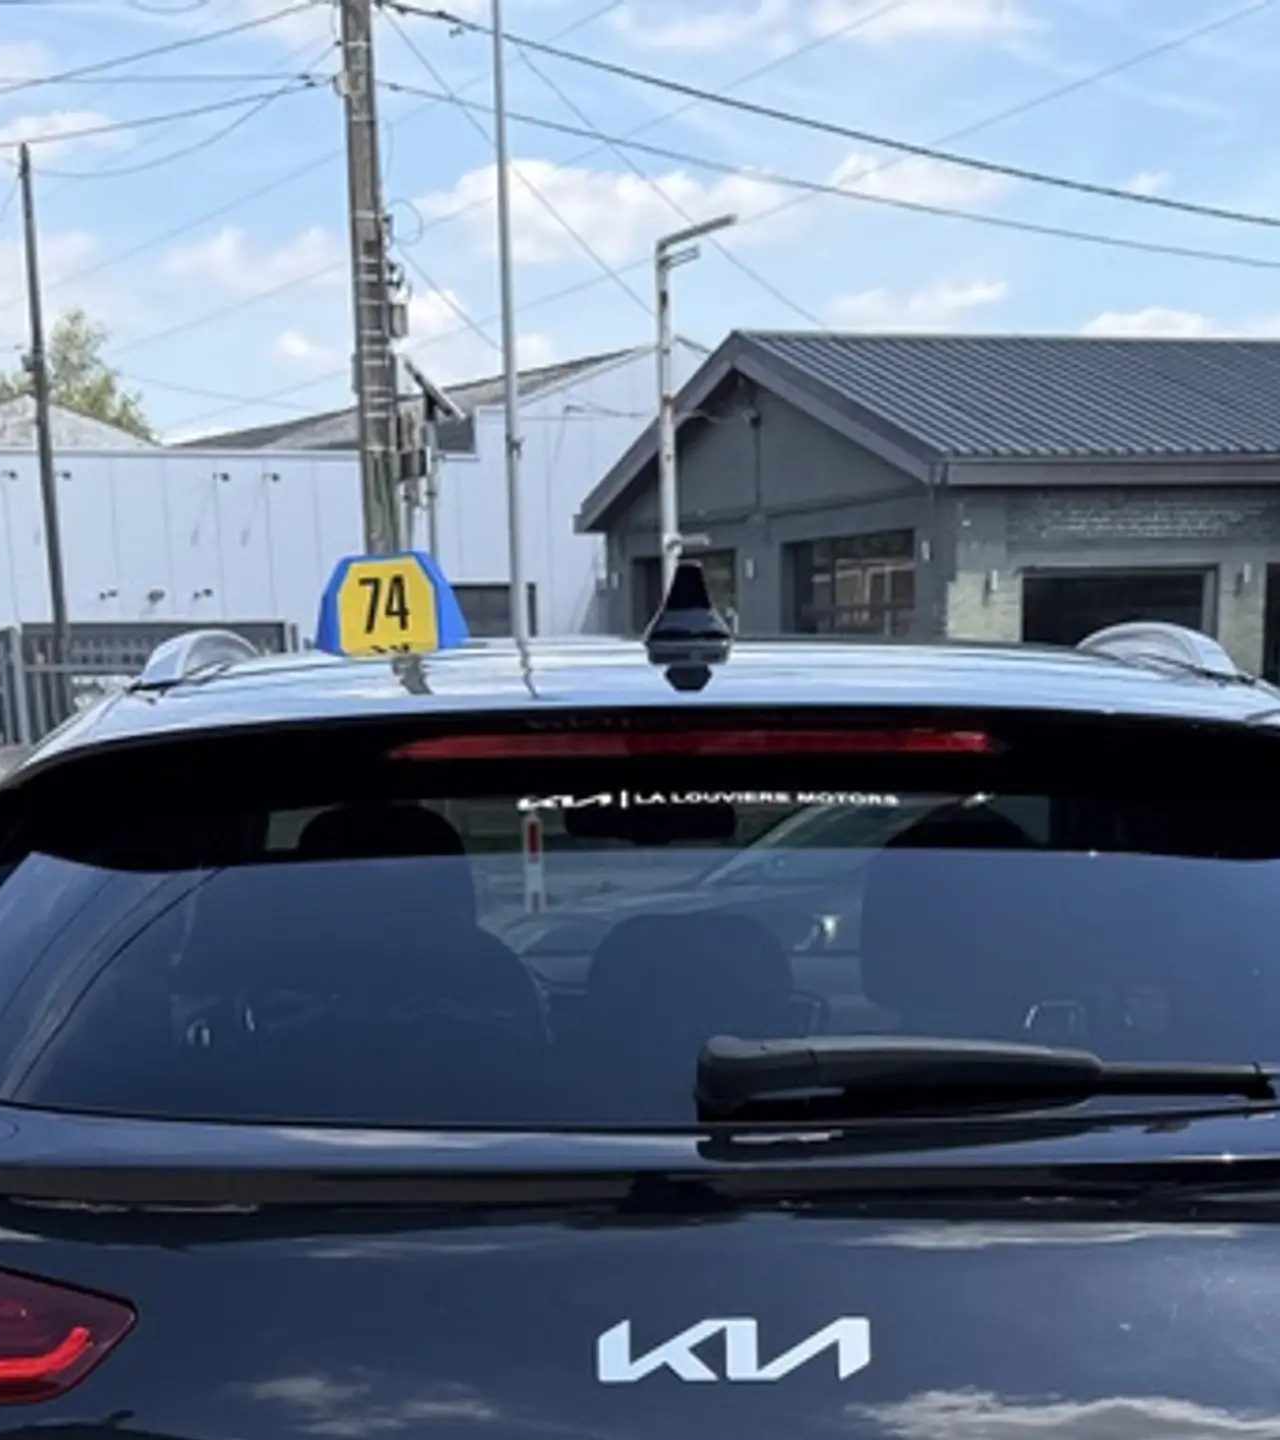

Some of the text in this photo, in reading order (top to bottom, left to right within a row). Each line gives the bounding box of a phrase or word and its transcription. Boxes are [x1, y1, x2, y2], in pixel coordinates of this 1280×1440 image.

[358, 574, 410, 634] 74
[516, 793, 613, 811] KIA
[634, 792, 665, 804] LA
[796, 792, 900, 807] MOTORS
[597, 1316, 872, 1382] KIA
